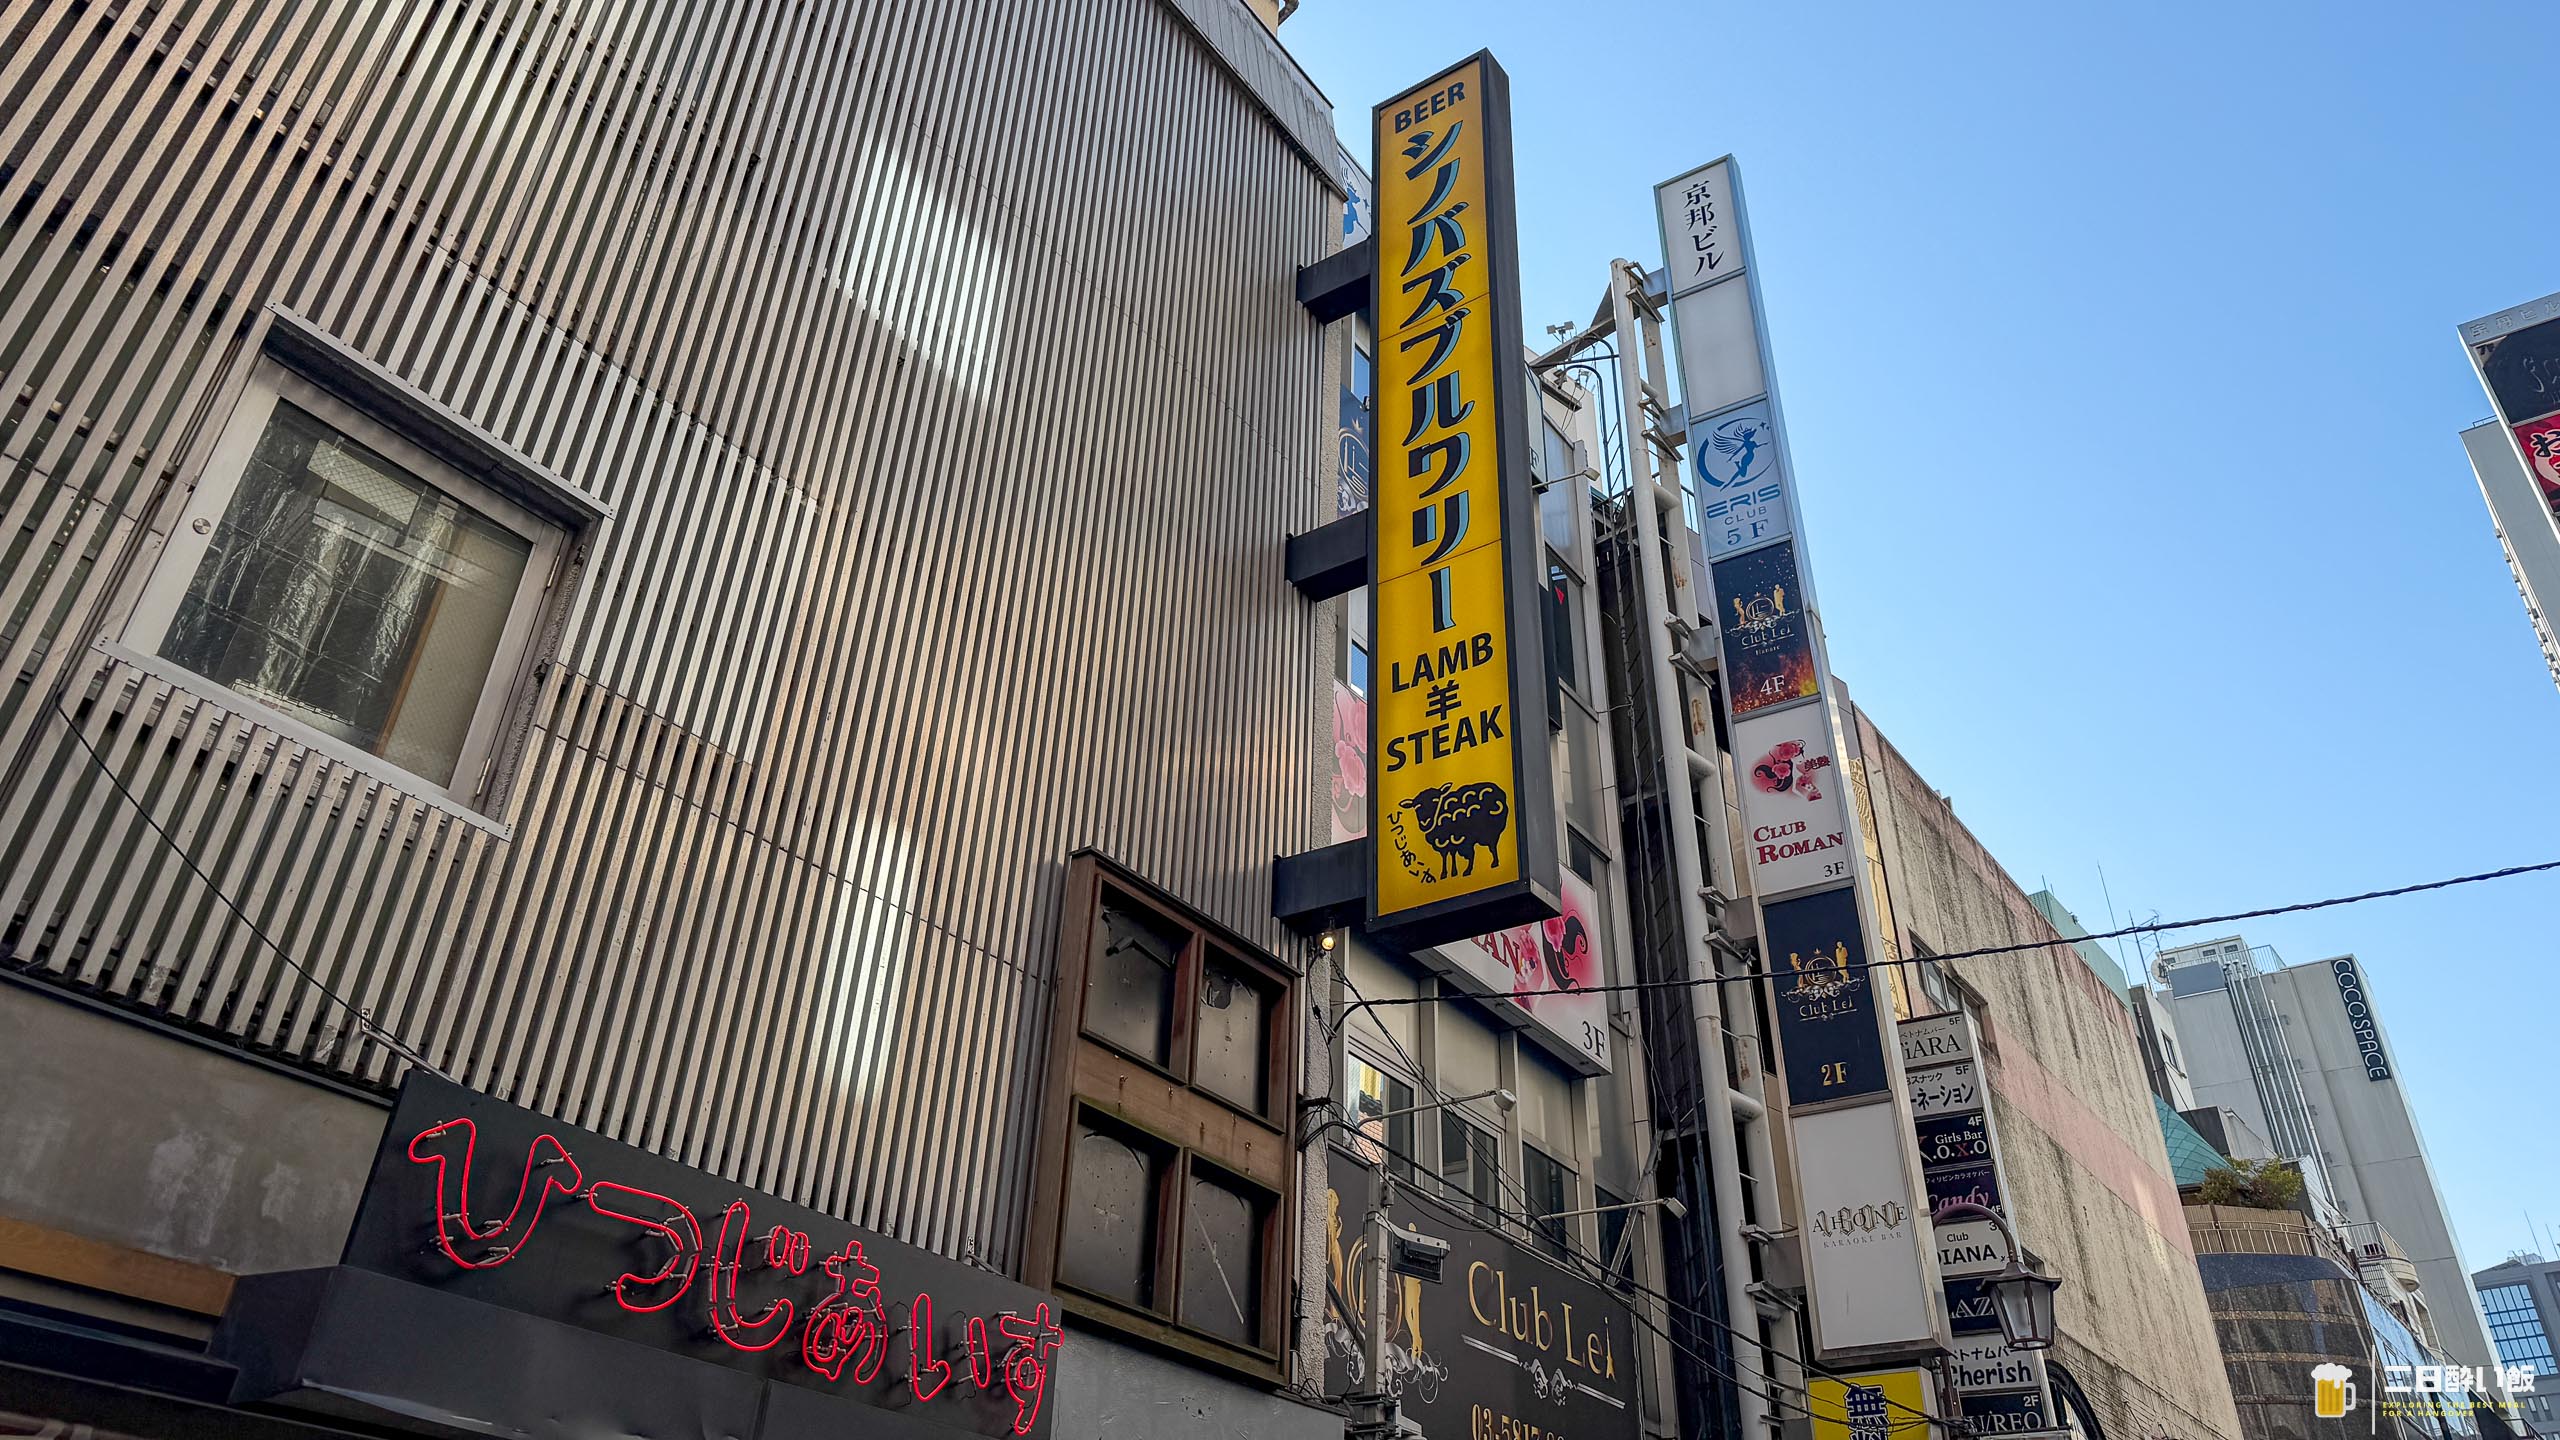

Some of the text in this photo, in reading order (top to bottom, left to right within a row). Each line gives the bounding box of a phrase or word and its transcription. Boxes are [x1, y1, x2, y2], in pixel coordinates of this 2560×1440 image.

[1395, 81, 1465, 133] BEER
[1682, 180, 1724, 276] 京邦ビル
[1400, 120, 1475, 633] シノバズブルワリー
[1706, 484, 1780, 518] ERIS
[1724, 506, 1767, 525] CLUB
[1741, 630, 1768, 647] Club
[1391, 632, 1493, 693] LAMB
[1760, 675, 1785, 695] 4F
[1426, 680, 1461, 720] 羊
[1387, 704, 1504, 772] STEAK
[1753, 821, 1806, 842] CLUB
[1757, 832, 1844, 865] ROMAN
[1824, 862, 1844, 877] 3F
[1800, 996, 1853, 1018] Club Lei
[2334, 960, 2387, 1078] COCOSPACE
[1949, 1016, 1960, 1026] 5F
[1582, 1020, 1605, 1060] 3F
[1900, 1034, 1962, 1060] iARA
[1821, 1061, 1847, 1087] 2F
[1955, 1065, 1969, 1076] 5F
[1968, 1115, 1982, 1126] 4F
[1935, 1130, 1983, 1144] Girls Bar
[1928, 1185, 1989, 1215] Candy
[1823, 1230, 1903, 1249] KARAOKE BAR
[1947, 1232, 1969, 1243] Club
[407, 1117, 1064, 1435] ひつじあいす
[1468, 1261, 1617, 1382] Club Lei
[2023, 1395, 2039, 1407] 2F
